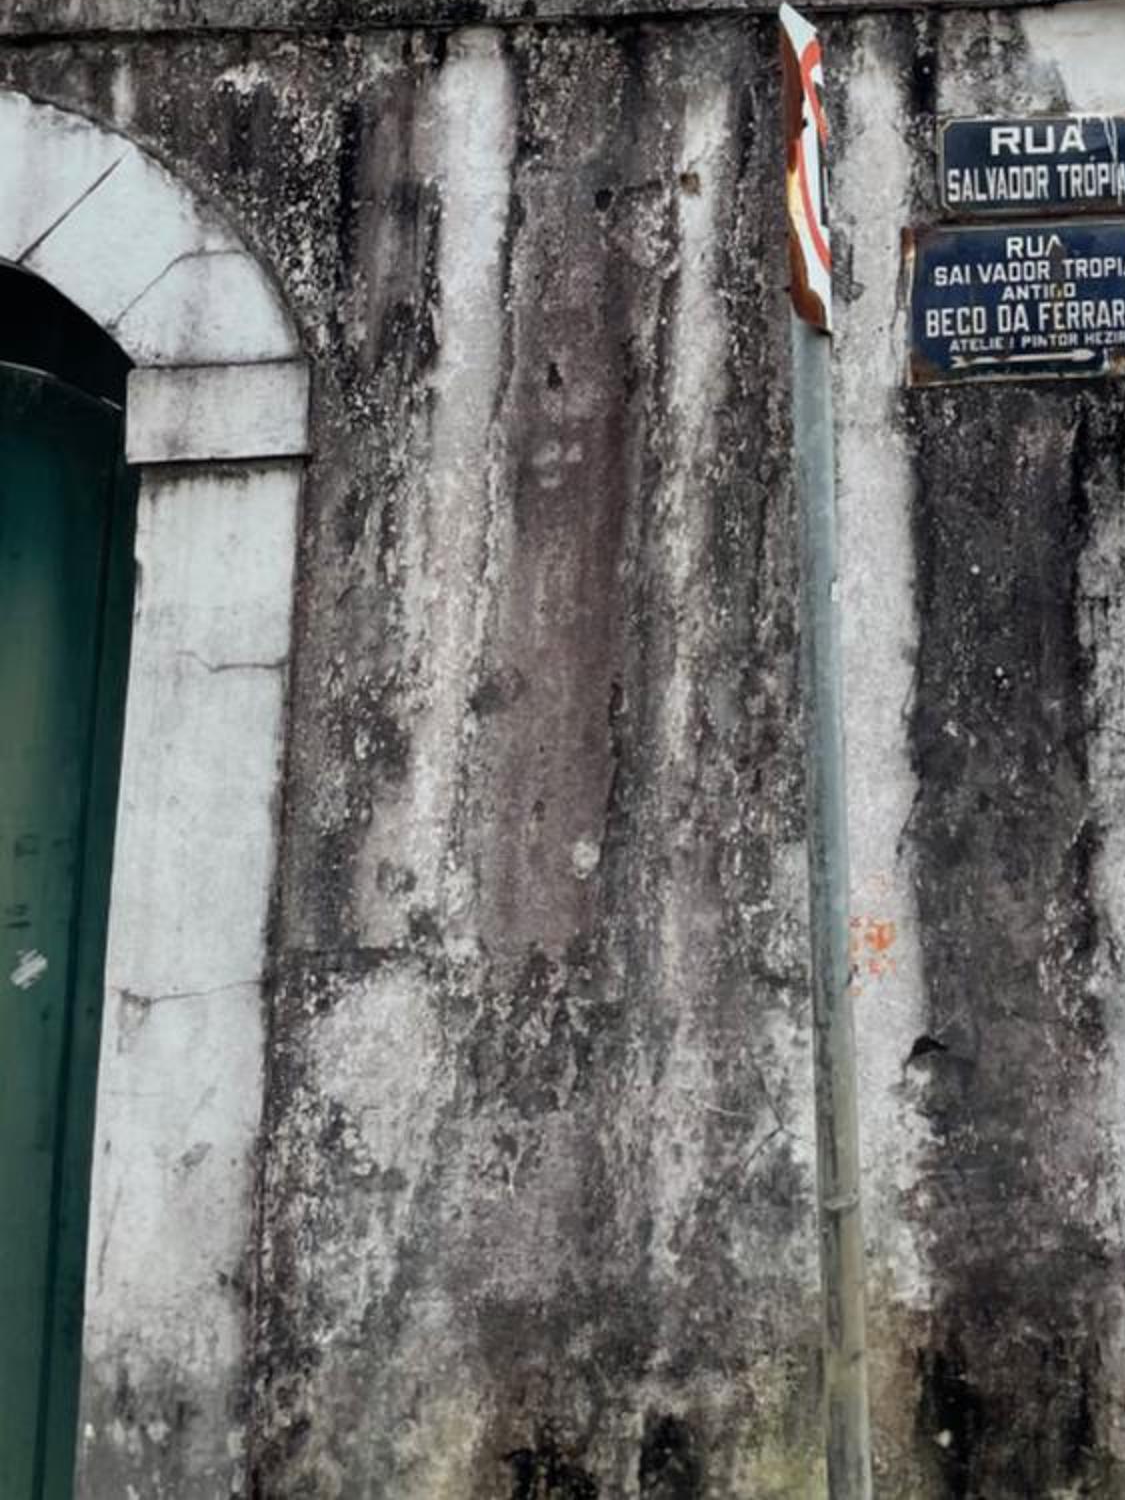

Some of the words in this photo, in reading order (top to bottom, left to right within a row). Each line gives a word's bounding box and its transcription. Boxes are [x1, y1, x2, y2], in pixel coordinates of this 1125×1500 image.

[990, 125, 1087, 156] RUA
[947, 165, 1050, 202] SALVADOR
[1006, 234, 1063, 259] RUA
[926, 307, 987, 338] BECO
[998, 303, 1029, 334] DA
